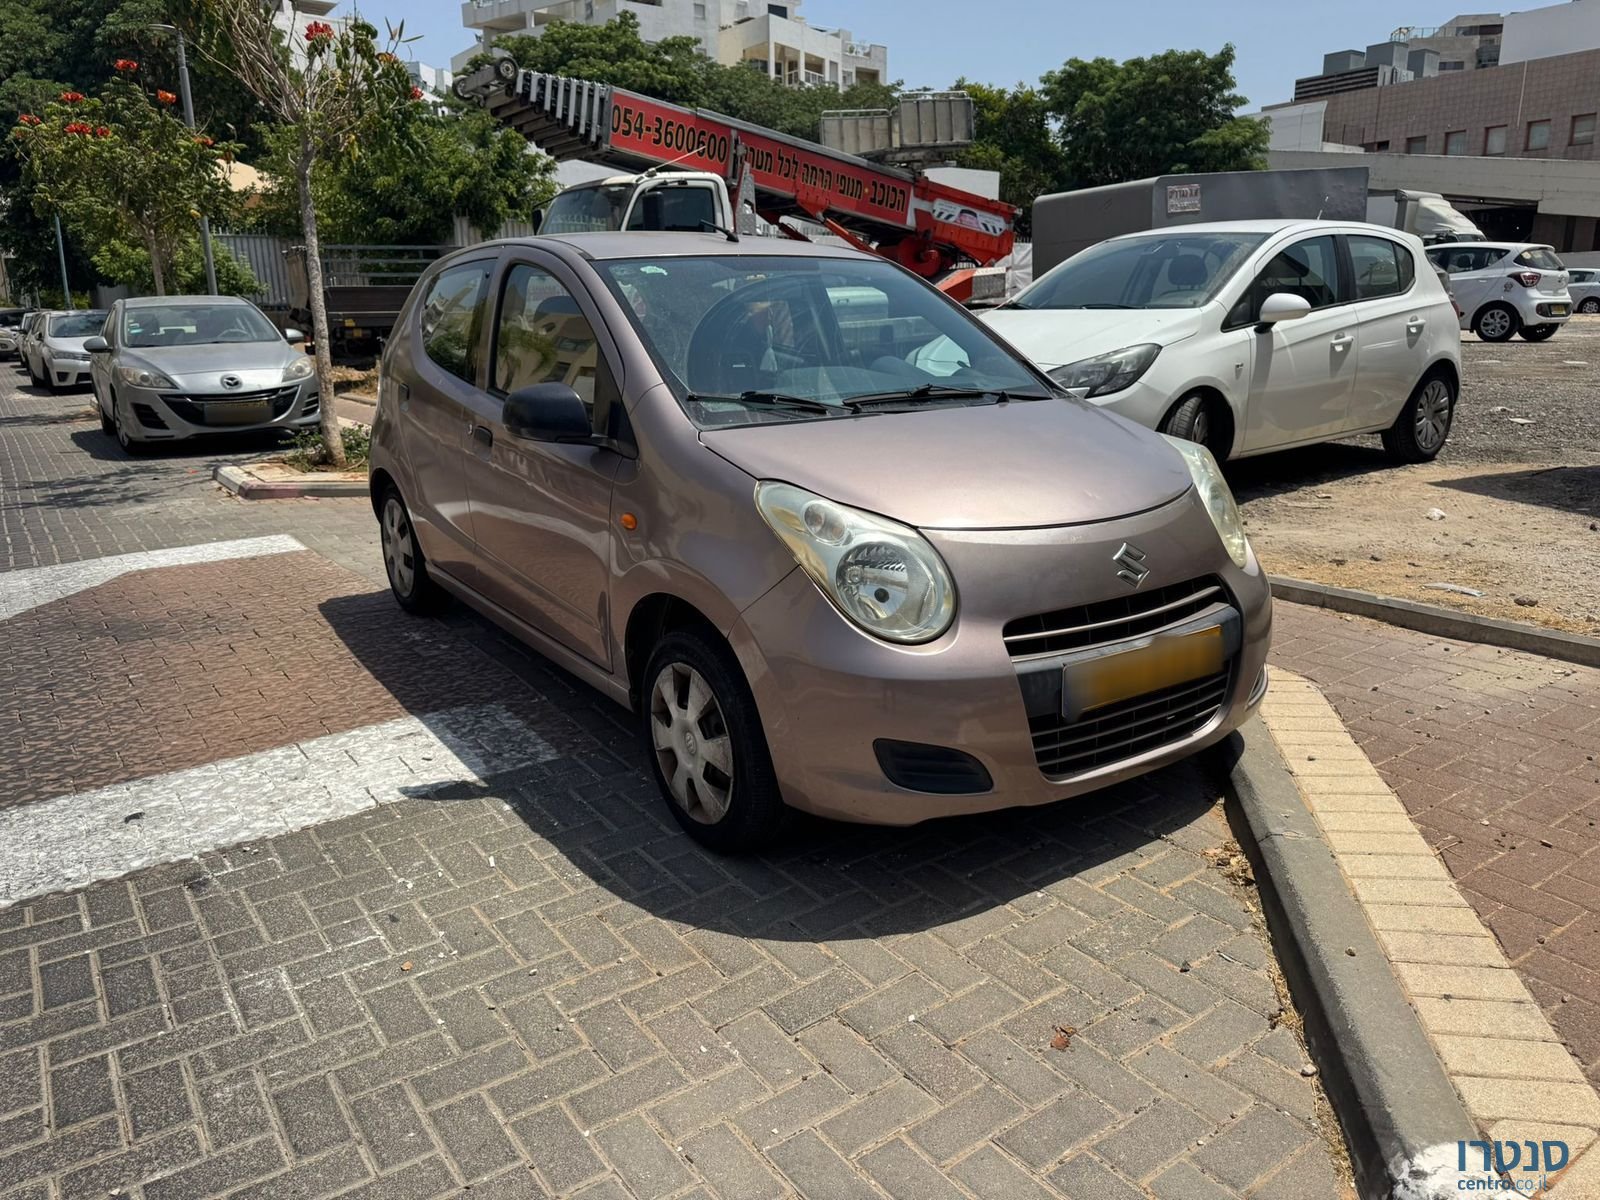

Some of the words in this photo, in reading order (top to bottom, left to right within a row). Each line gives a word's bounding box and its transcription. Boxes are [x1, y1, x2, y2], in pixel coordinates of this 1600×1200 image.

[611, 104, 728, 163] 054-3600600
[777, 147, 799, 180] לכל
[801, 163, 833, 190] הרמה
[869, 180, 906, 212] הכוכב
